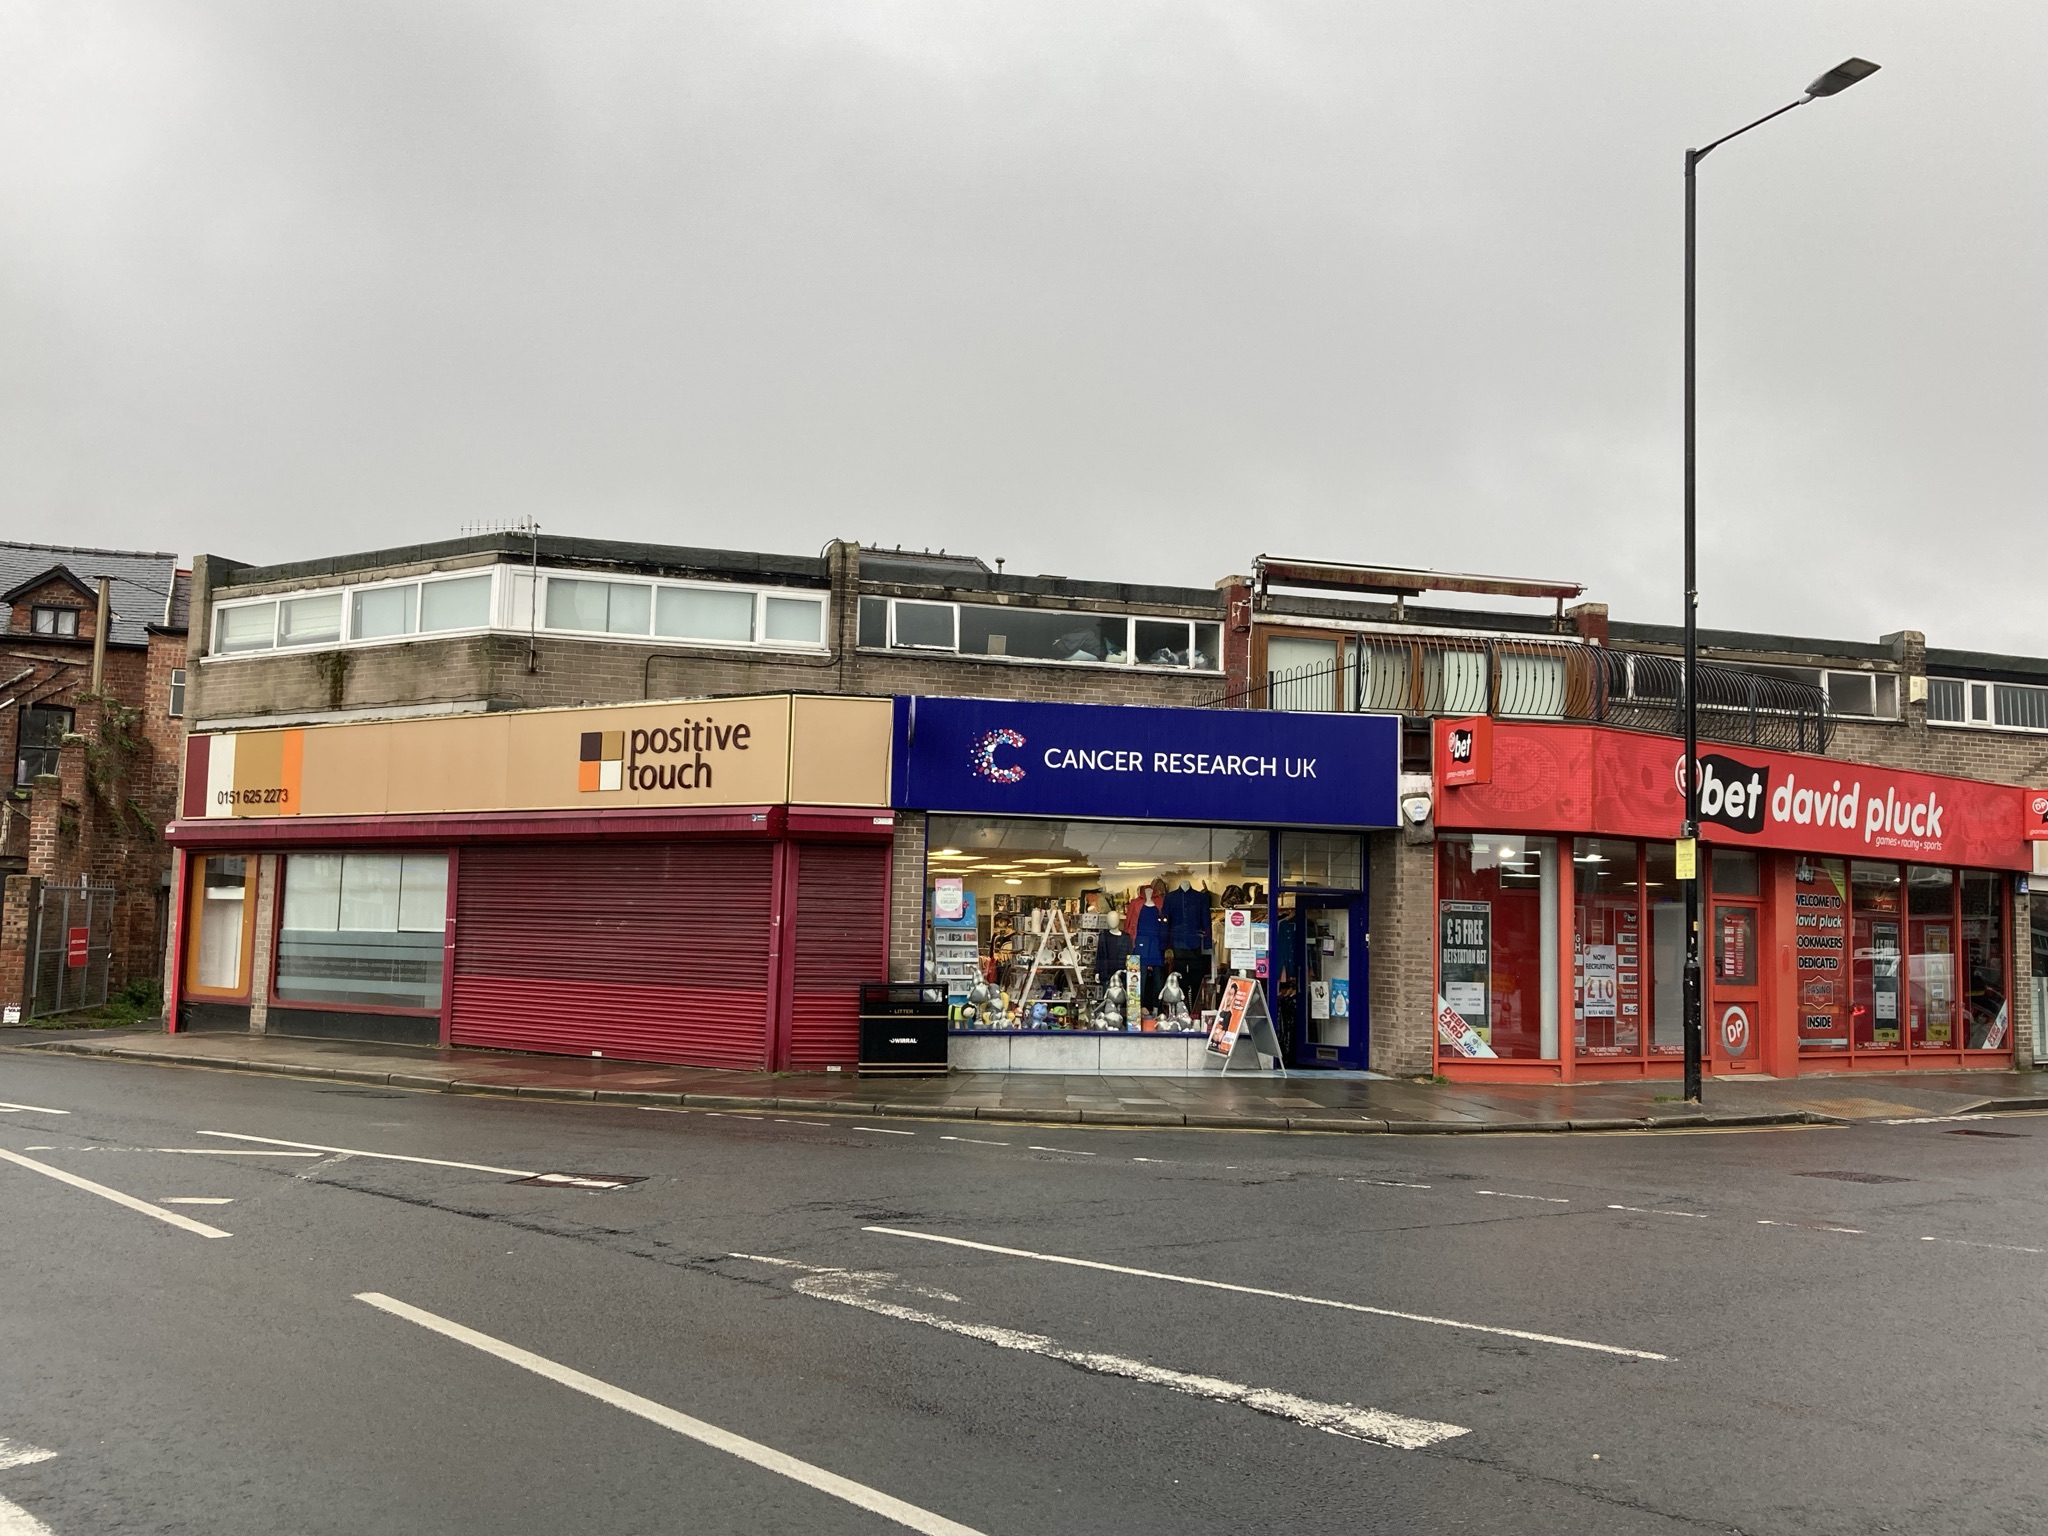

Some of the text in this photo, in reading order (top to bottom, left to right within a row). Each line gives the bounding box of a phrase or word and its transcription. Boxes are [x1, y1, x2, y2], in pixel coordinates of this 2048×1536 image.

[629, 717, 751, 766] positive
[1454, 733, 1472, 759] bet
[627, 752, 713, 791] touch
[1044, 748, 1317, 778] CANCER RESEARCH UK
[217, 788, 288, 805] 0151 625 2273
[1701, 763, 1763, 820] bet
[1771, 774, 1861, 829] david
[1864, 787, 1944, 843] pluck
[1875, 836, 1942, 852] games racing sports
[1831, 897, 1841, 909] TO
[1819, 914, 1842, 930] pluck
[1463, 919, 1483, 945] FREE
[1796, 935, 1843, 949] OOKMAKERS
[1476, 949, 1487, 965] BET
[1798, 956, 1838, 970] DEDICATED
[1587, 979, 1614, 999] £10
[1807, 985, 1831, 995] CASINO
[1439, 1013, 1463, 1040] CARD
[1443, 1006, 1471, 1034] DEBIT
[1807, 1015, 1832, 1029] INSIDE
[1727, 1019, 1744, 1043] DP
[1463, 1041, 1478, 1056] VISA
